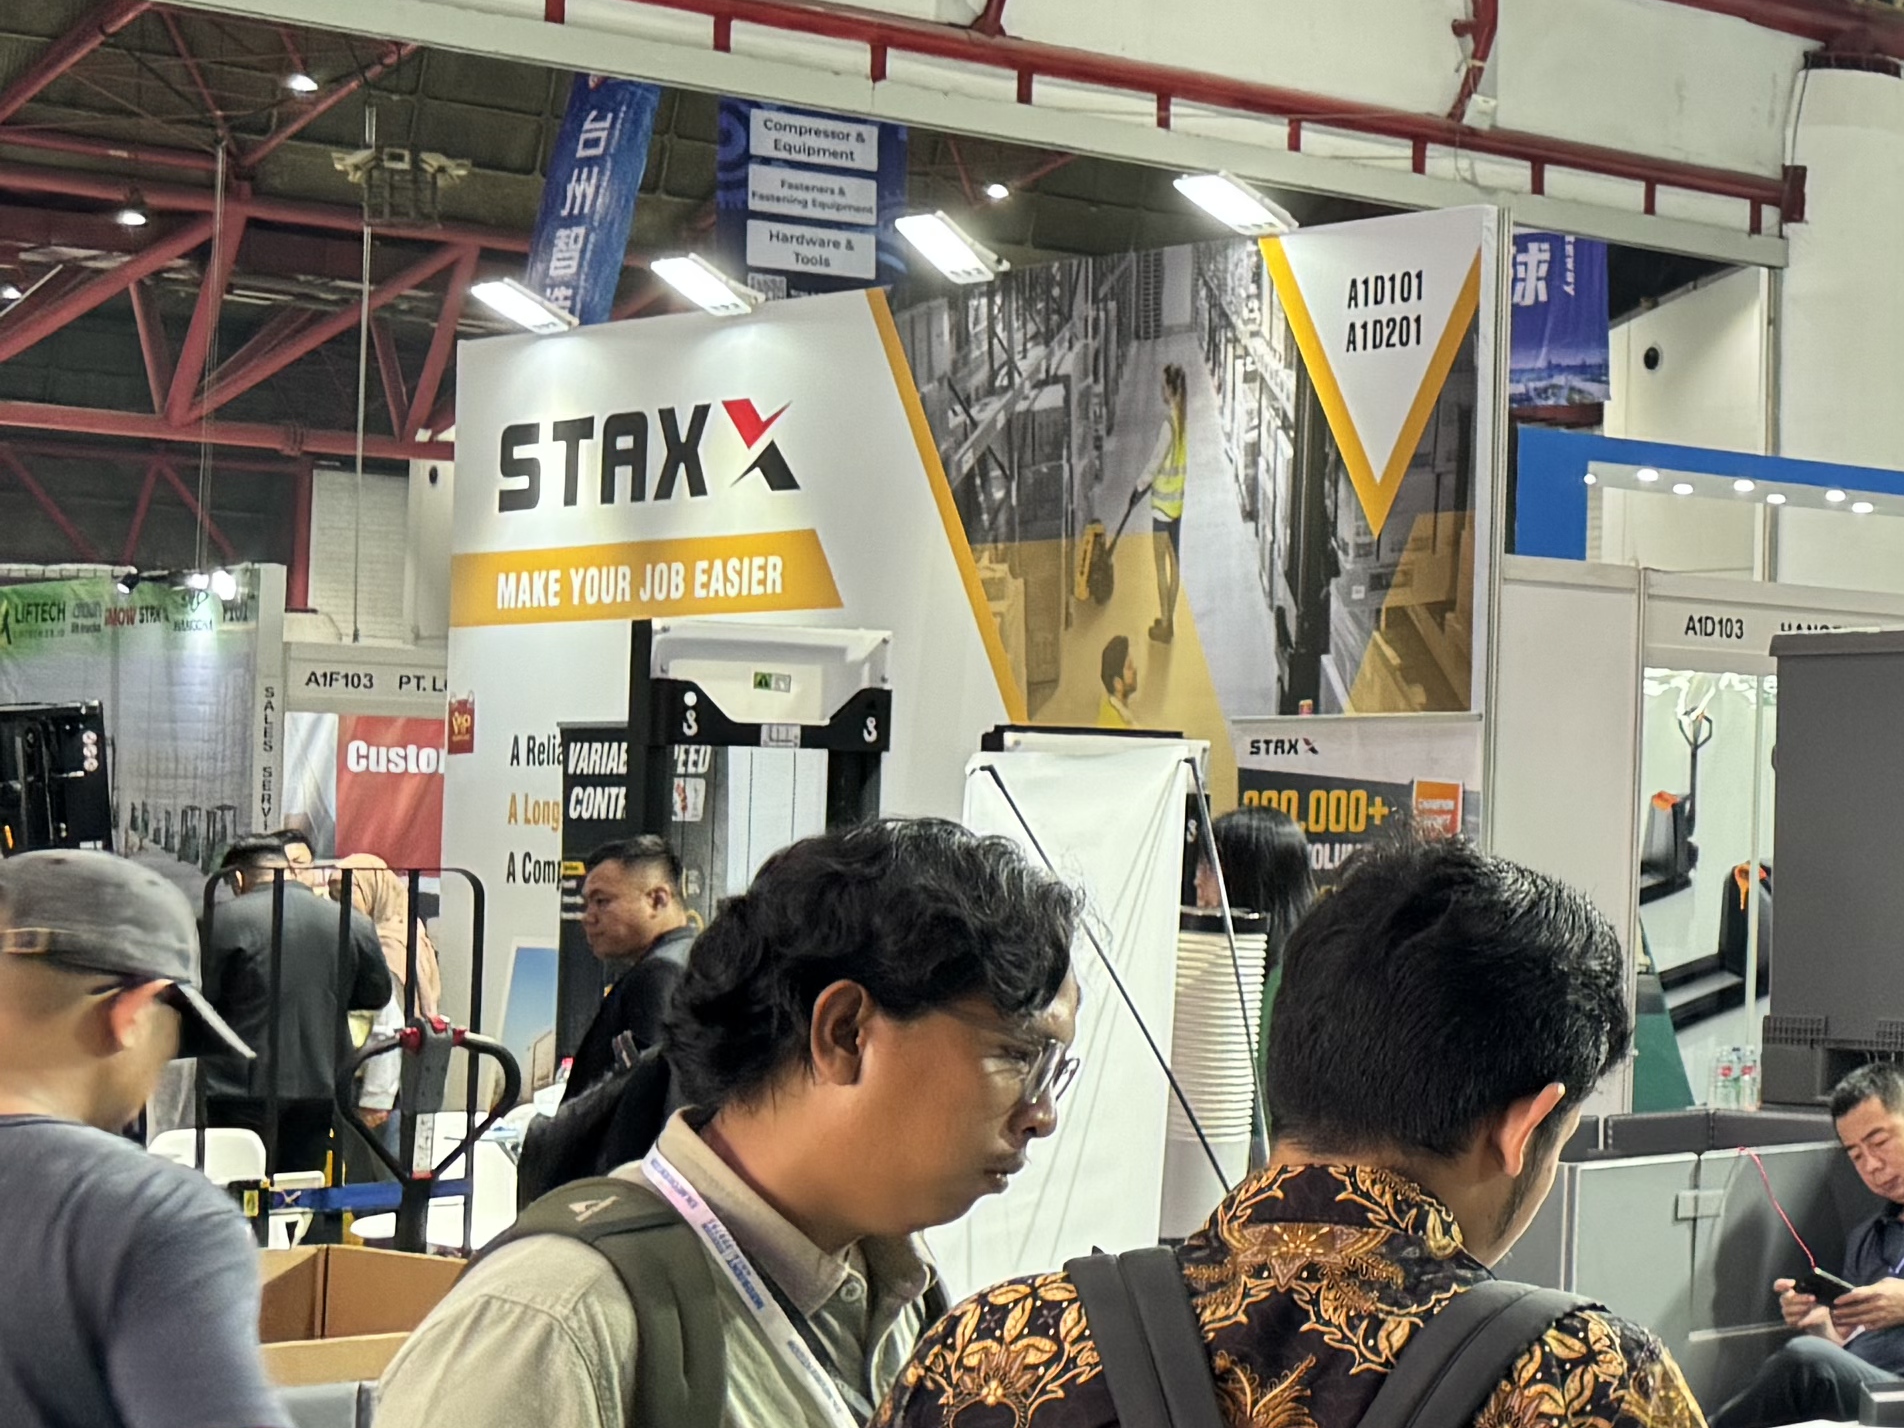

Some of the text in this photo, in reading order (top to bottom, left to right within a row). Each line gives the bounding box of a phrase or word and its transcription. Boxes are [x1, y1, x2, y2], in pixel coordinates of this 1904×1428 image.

[763, 118, 866, 144] Compressor &
[774, 139, 855, 162] Equipment
[781, 179, 836, 196] Fasteners
[751, 190, 873, 215] Fastening Equipment
[769, 229, 854, 252] Hardware &
[793, 250, 831, 268] Tools
[1346, 269, 1425, 311] A1D101
[1345, 314, 1424, 354] A1D201
[496, 555, 783, 611] MAKE YOUR JOB EASIER
[14, 601, 66, 623] LIFTECH
[1684, 614, 1744, 640] A1D103
[305, 671, 447, 693] A1F103 PT. L
[263, 687, 275, 753] SALES
[510, 734, 520, 767] A
[674, 745, 712, 775] EED
[508, 792, 518, 825] A
[506, 850, 516, 884] A
